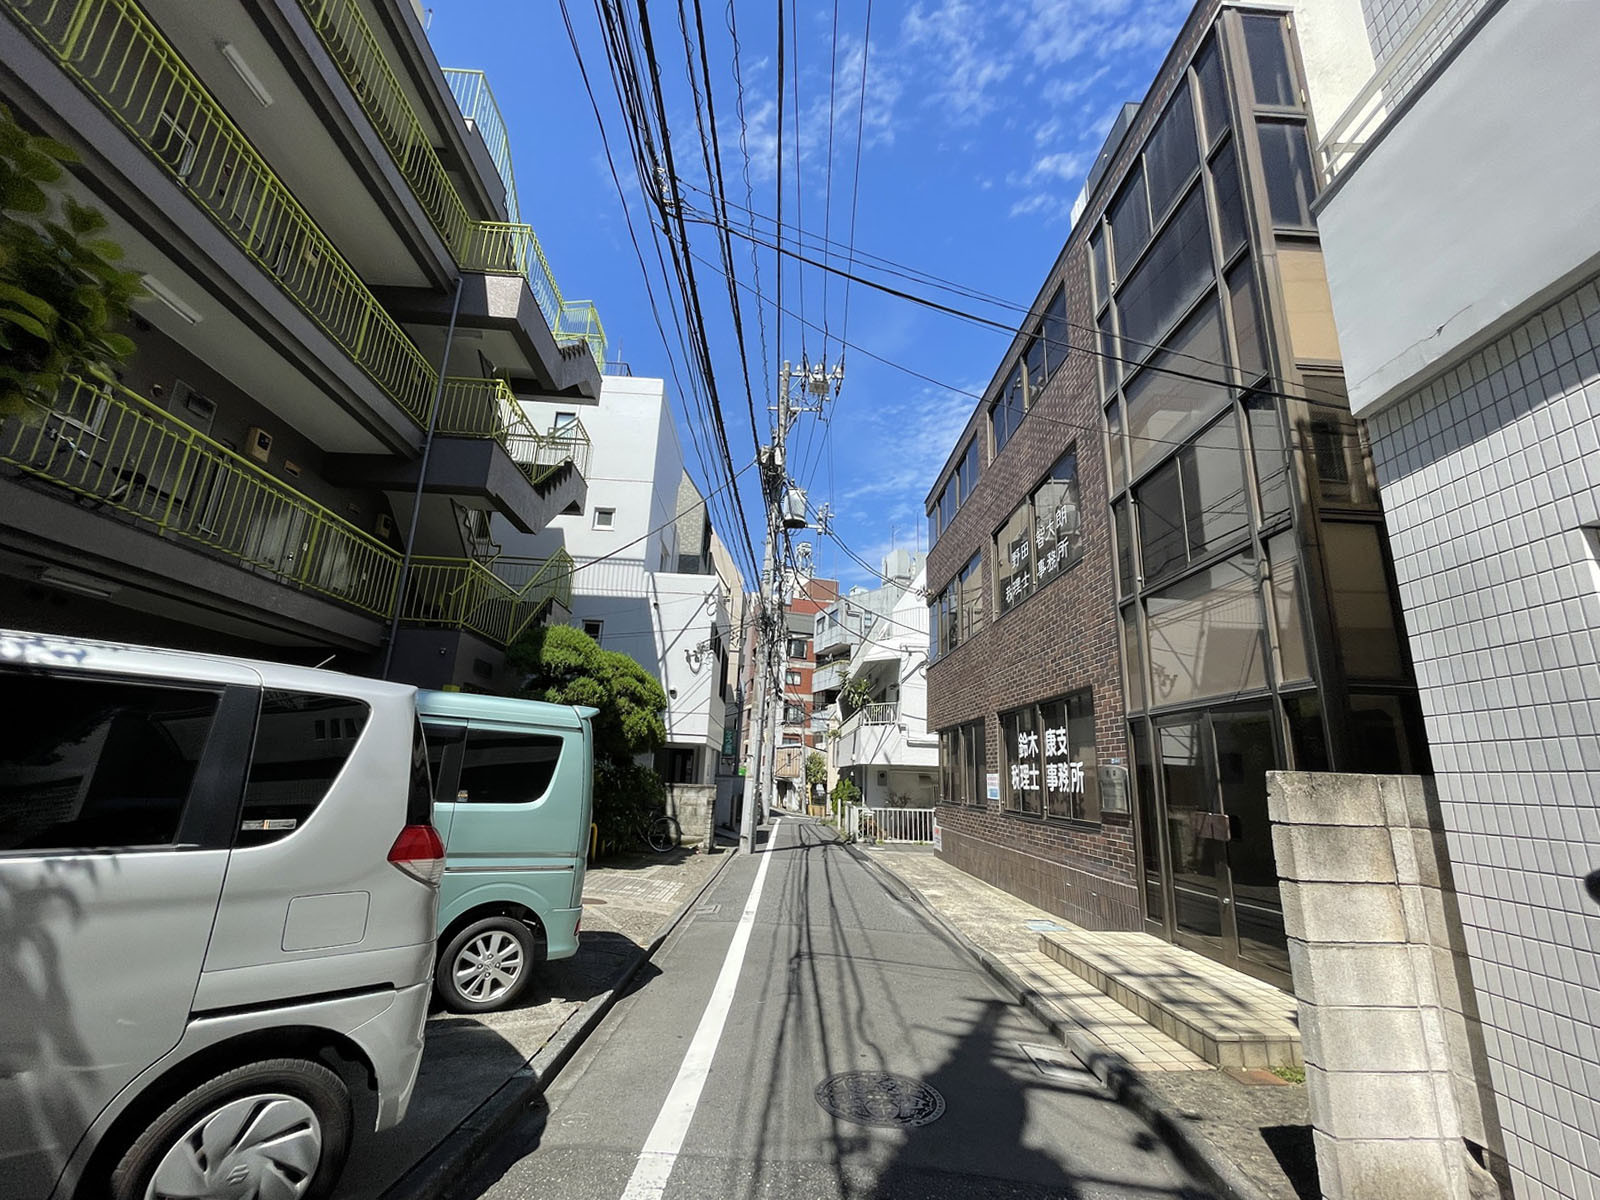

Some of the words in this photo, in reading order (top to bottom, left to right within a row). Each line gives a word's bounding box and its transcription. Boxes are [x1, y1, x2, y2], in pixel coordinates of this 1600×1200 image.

[1006, 571, 1030, 603] 税理士
[1037, 536, 1069, 579] 事務所
[1018, 731, 1039, 758] 鈴木
[1011, 763, 1040, 790] 税理士
[1046, 761, 1085, 794] 事務所
